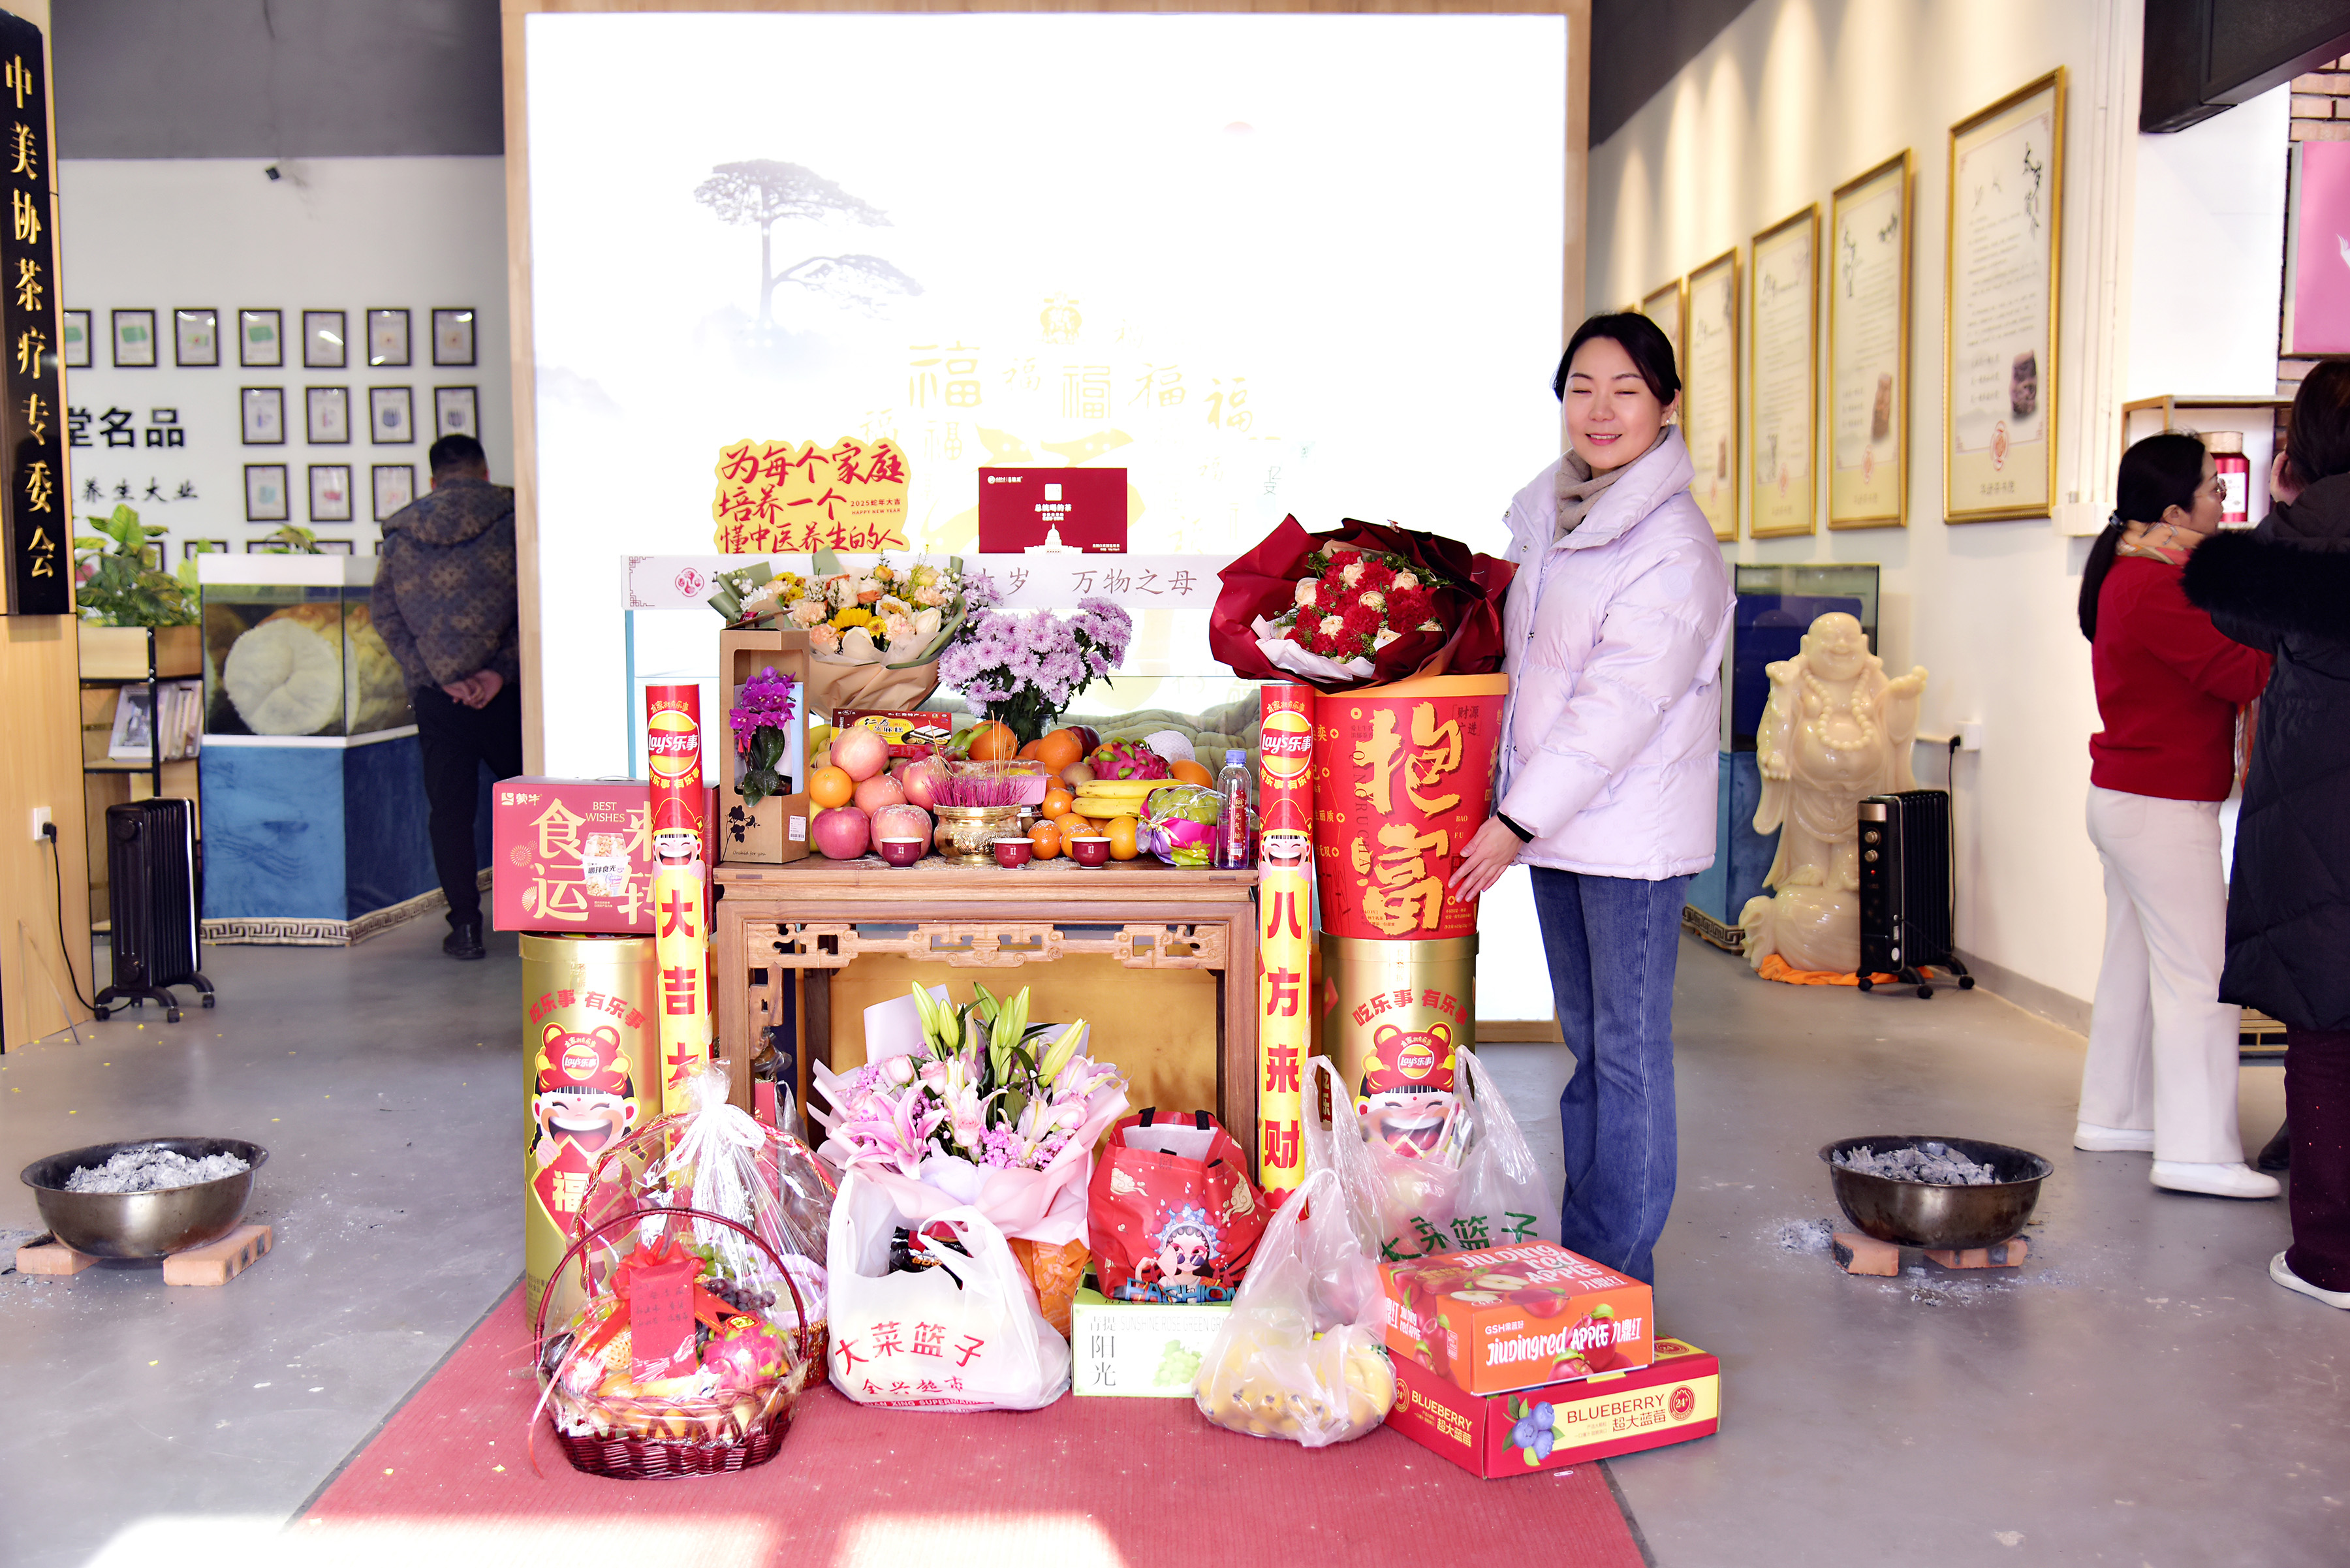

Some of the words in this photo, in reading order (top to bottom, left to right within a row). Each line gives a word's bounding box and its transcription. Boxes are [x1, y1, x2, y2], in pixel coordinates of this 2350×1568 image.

[5, 54, 56, 579] 中美协茶疗专委会
[721, 442, 905, 487] 为每个家庭
[718, 484, 847, 525] 培养一个
[851, 498, 901, 507] 2025蛇年大吉
[719, 521, 904, 554] 懂中医养生的人
[1071, 567, 1197, 596] 万物之母
[1457, 705, 1479, 719] 财源
[516, 792, 540, 806] 蒙牛
[593, 802, 617, 810] BEST
[585, 813, 625, 823] WISHES
[529, 989, 576, 1025] 吃乐事
[585, 991, 646, 1029] 有乐事
[1352, 988, 1413, 1027] 吃乐事
[1422, 988, 1468, 1026] 有乐事
[661, 889, 699, 1162] 大吉大
[1265, 890, 1302, 1168] 八方来财
[565, 1057, 597, 1068] Lay's乐事
[1400, 1056, 1432, 1068] Lay's乐事
[552, 1170, 588, 1212] 福
[1578, 1276, 1628, 1291] 九鼎红
[1121, 1316, 1159, 1331] SUNSHINE
[1161, 1316, 1181, 1331] ROSE
[1183, 1316, 1208, 1331] GREEN
[1611, 1317, 1642, 1345] 九鼎红
[835, 1320, 984, 1376] 大菜篮子
[1090, 1335, 1116, 1387] 阳光
[862, 1375, 964, 1395] 全兴超市
[1411, 1390, 1473, 1432] BLUEBERRY
[1567, 1394, 1665, 1424] BLUEBERRY
[1612, 1409, 1667, 1432] 超大蓝莓
[1437, 1418, 1472, 1447] 超大蓝莓
